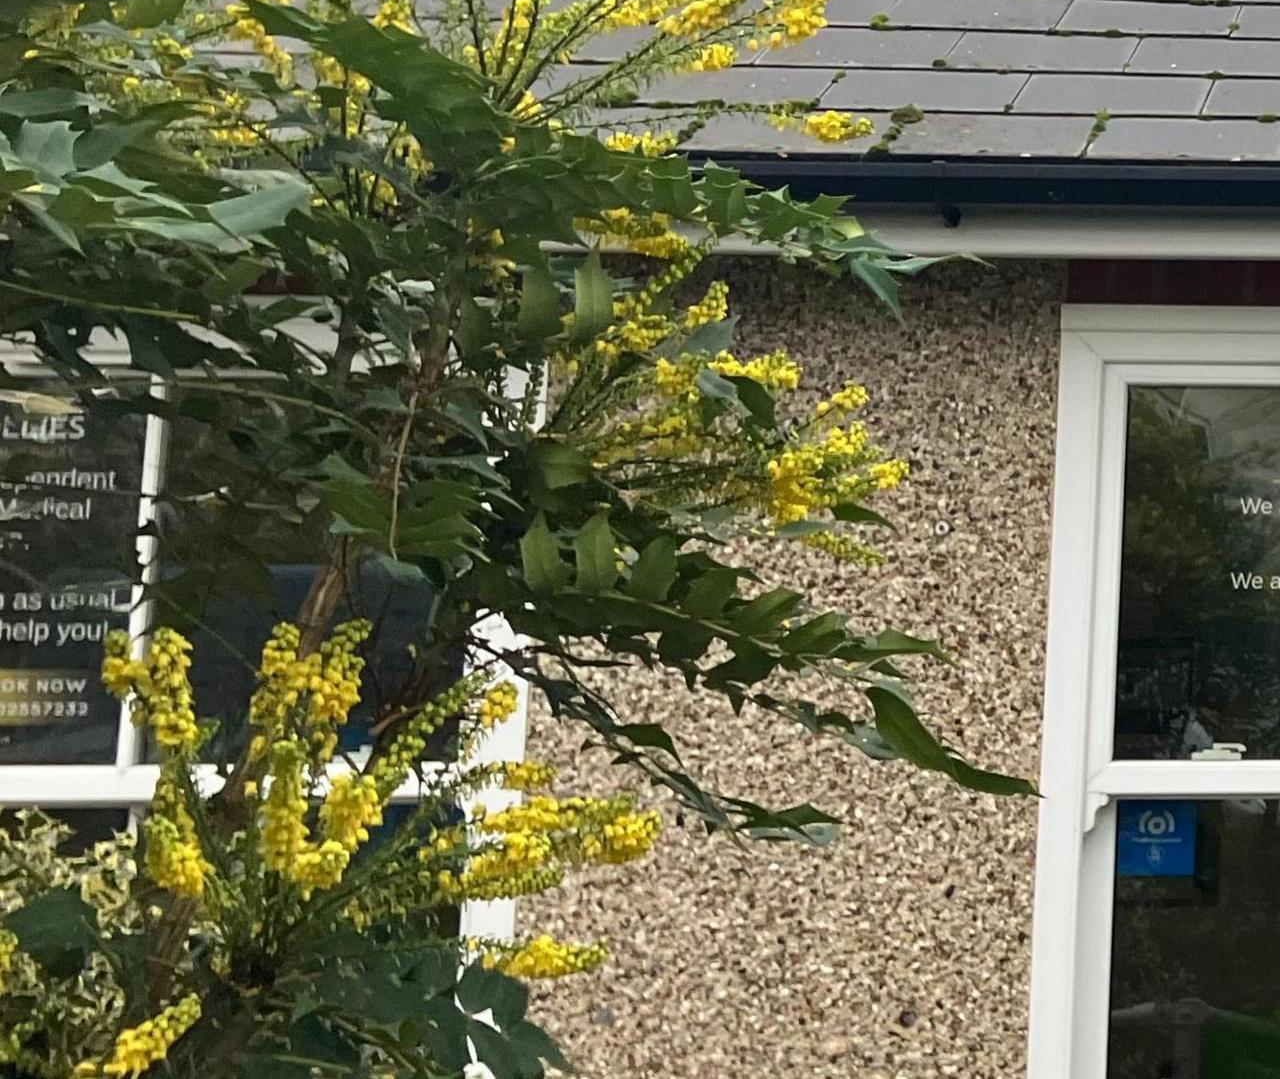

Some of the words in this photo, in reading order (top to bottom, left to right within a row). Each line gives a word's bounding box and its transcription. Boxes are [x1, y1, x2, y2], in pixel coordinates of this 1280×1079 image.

[1240, 497, 1273, 515] We
[1230, 572, 1264, 590] We
[13, 592, 42, 611] as
[37, 678, 86, 694] NOW
